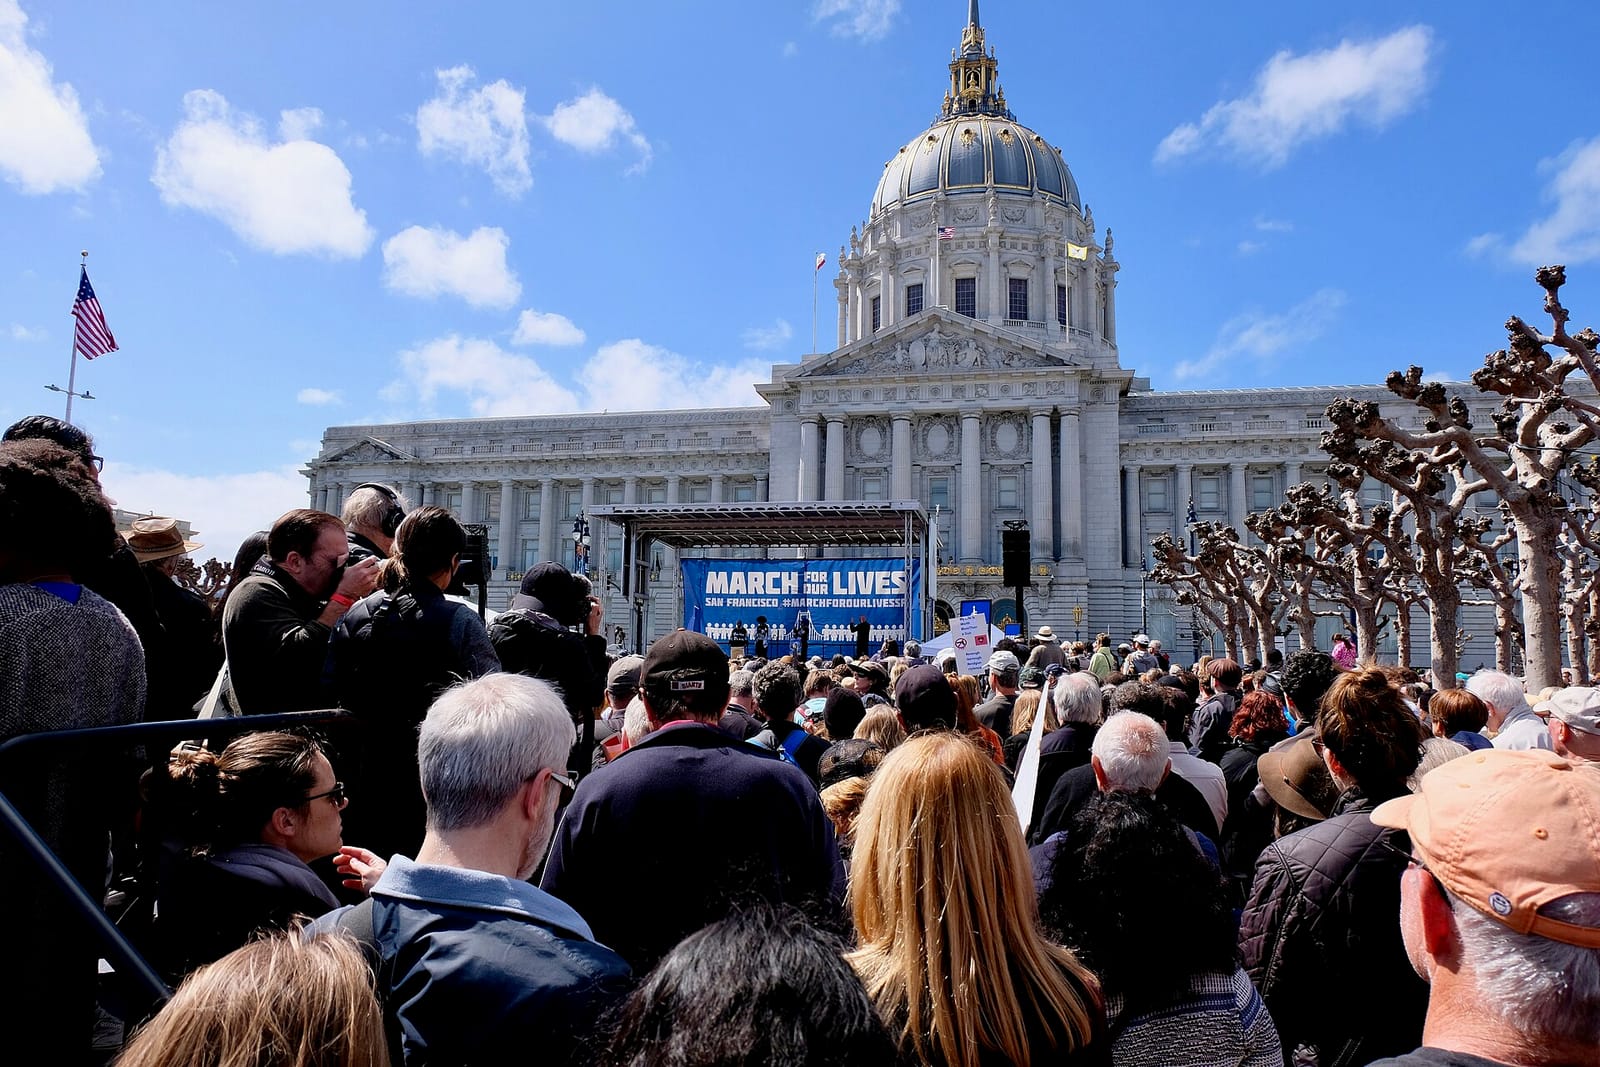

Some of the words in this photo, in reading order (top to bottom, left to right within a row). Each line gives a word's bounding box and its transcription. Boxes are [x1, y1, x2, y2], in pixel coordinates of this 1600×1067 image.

[803, 571, 828, 582] FOR
[705, 571, 799, 594] MARCH
[833, 571, 908, 595] LIVES
[803, 583, 828, 594] OUR
[705, 597, 724, 607] SAN
[726, 598, 778, 607] FRANCISCO
[680, 681, 702, 689] GIANTS
